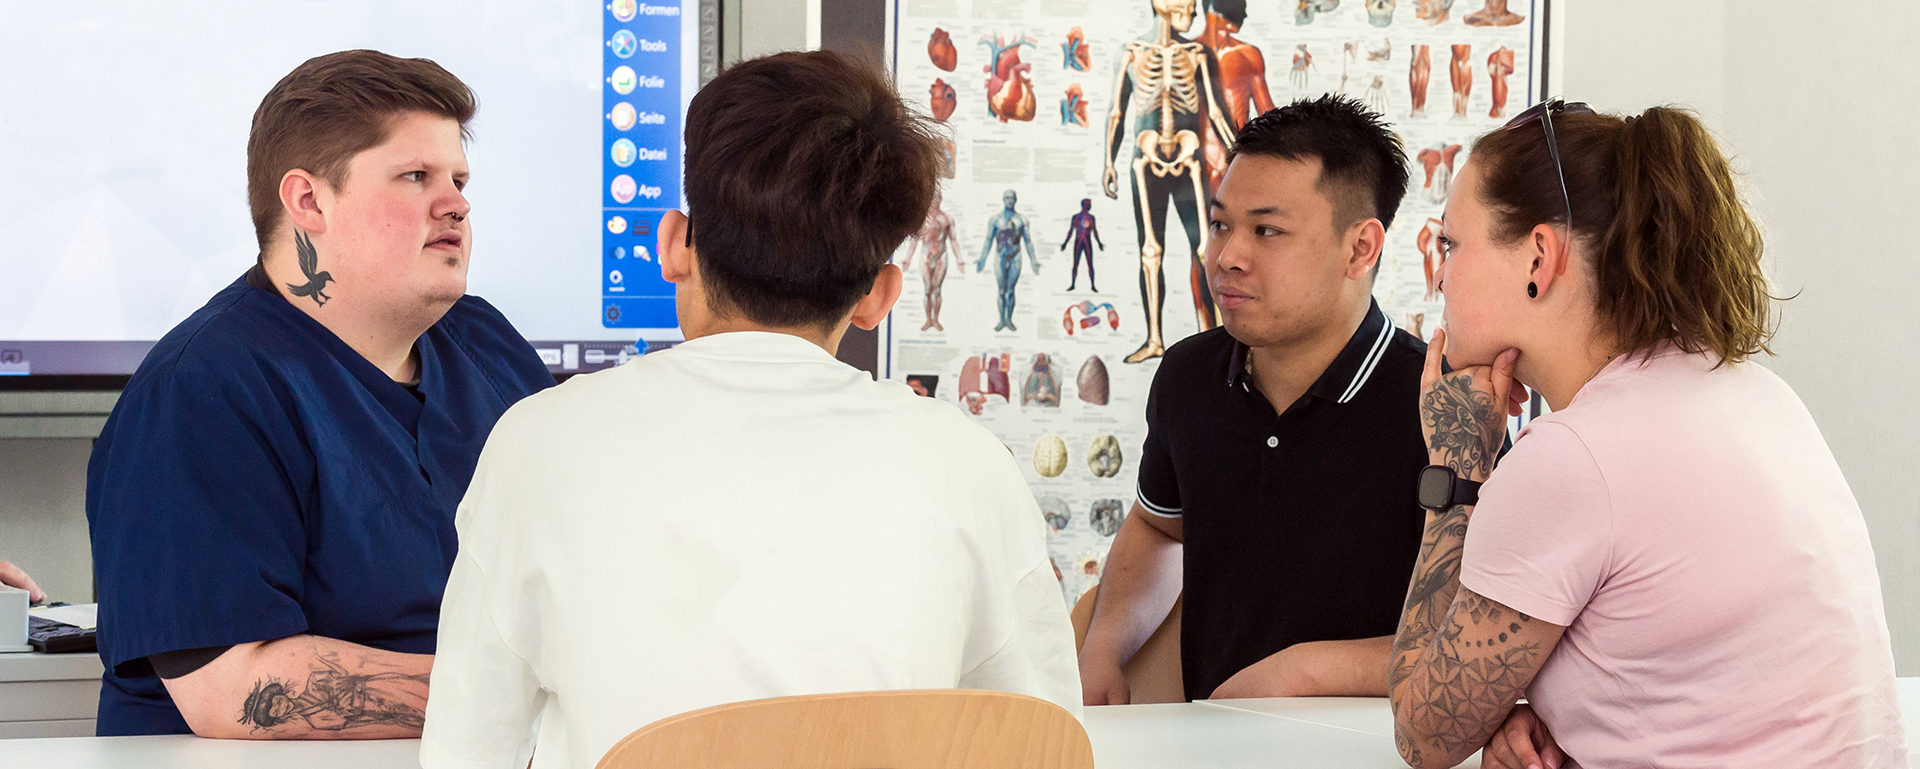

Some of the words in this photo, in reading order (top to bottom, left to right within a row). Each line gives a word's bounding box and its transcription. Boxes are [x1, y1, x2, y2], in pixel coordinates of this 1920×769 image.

[639, 3, 680, 16] Formen
[639, 39, 667, 52] Tools
[639, 75, 665, 88] Folie
[639, 112, 666, 125] Seite
[639, 148, 667, 161] Datei
[638, 184, 662, 200] App
